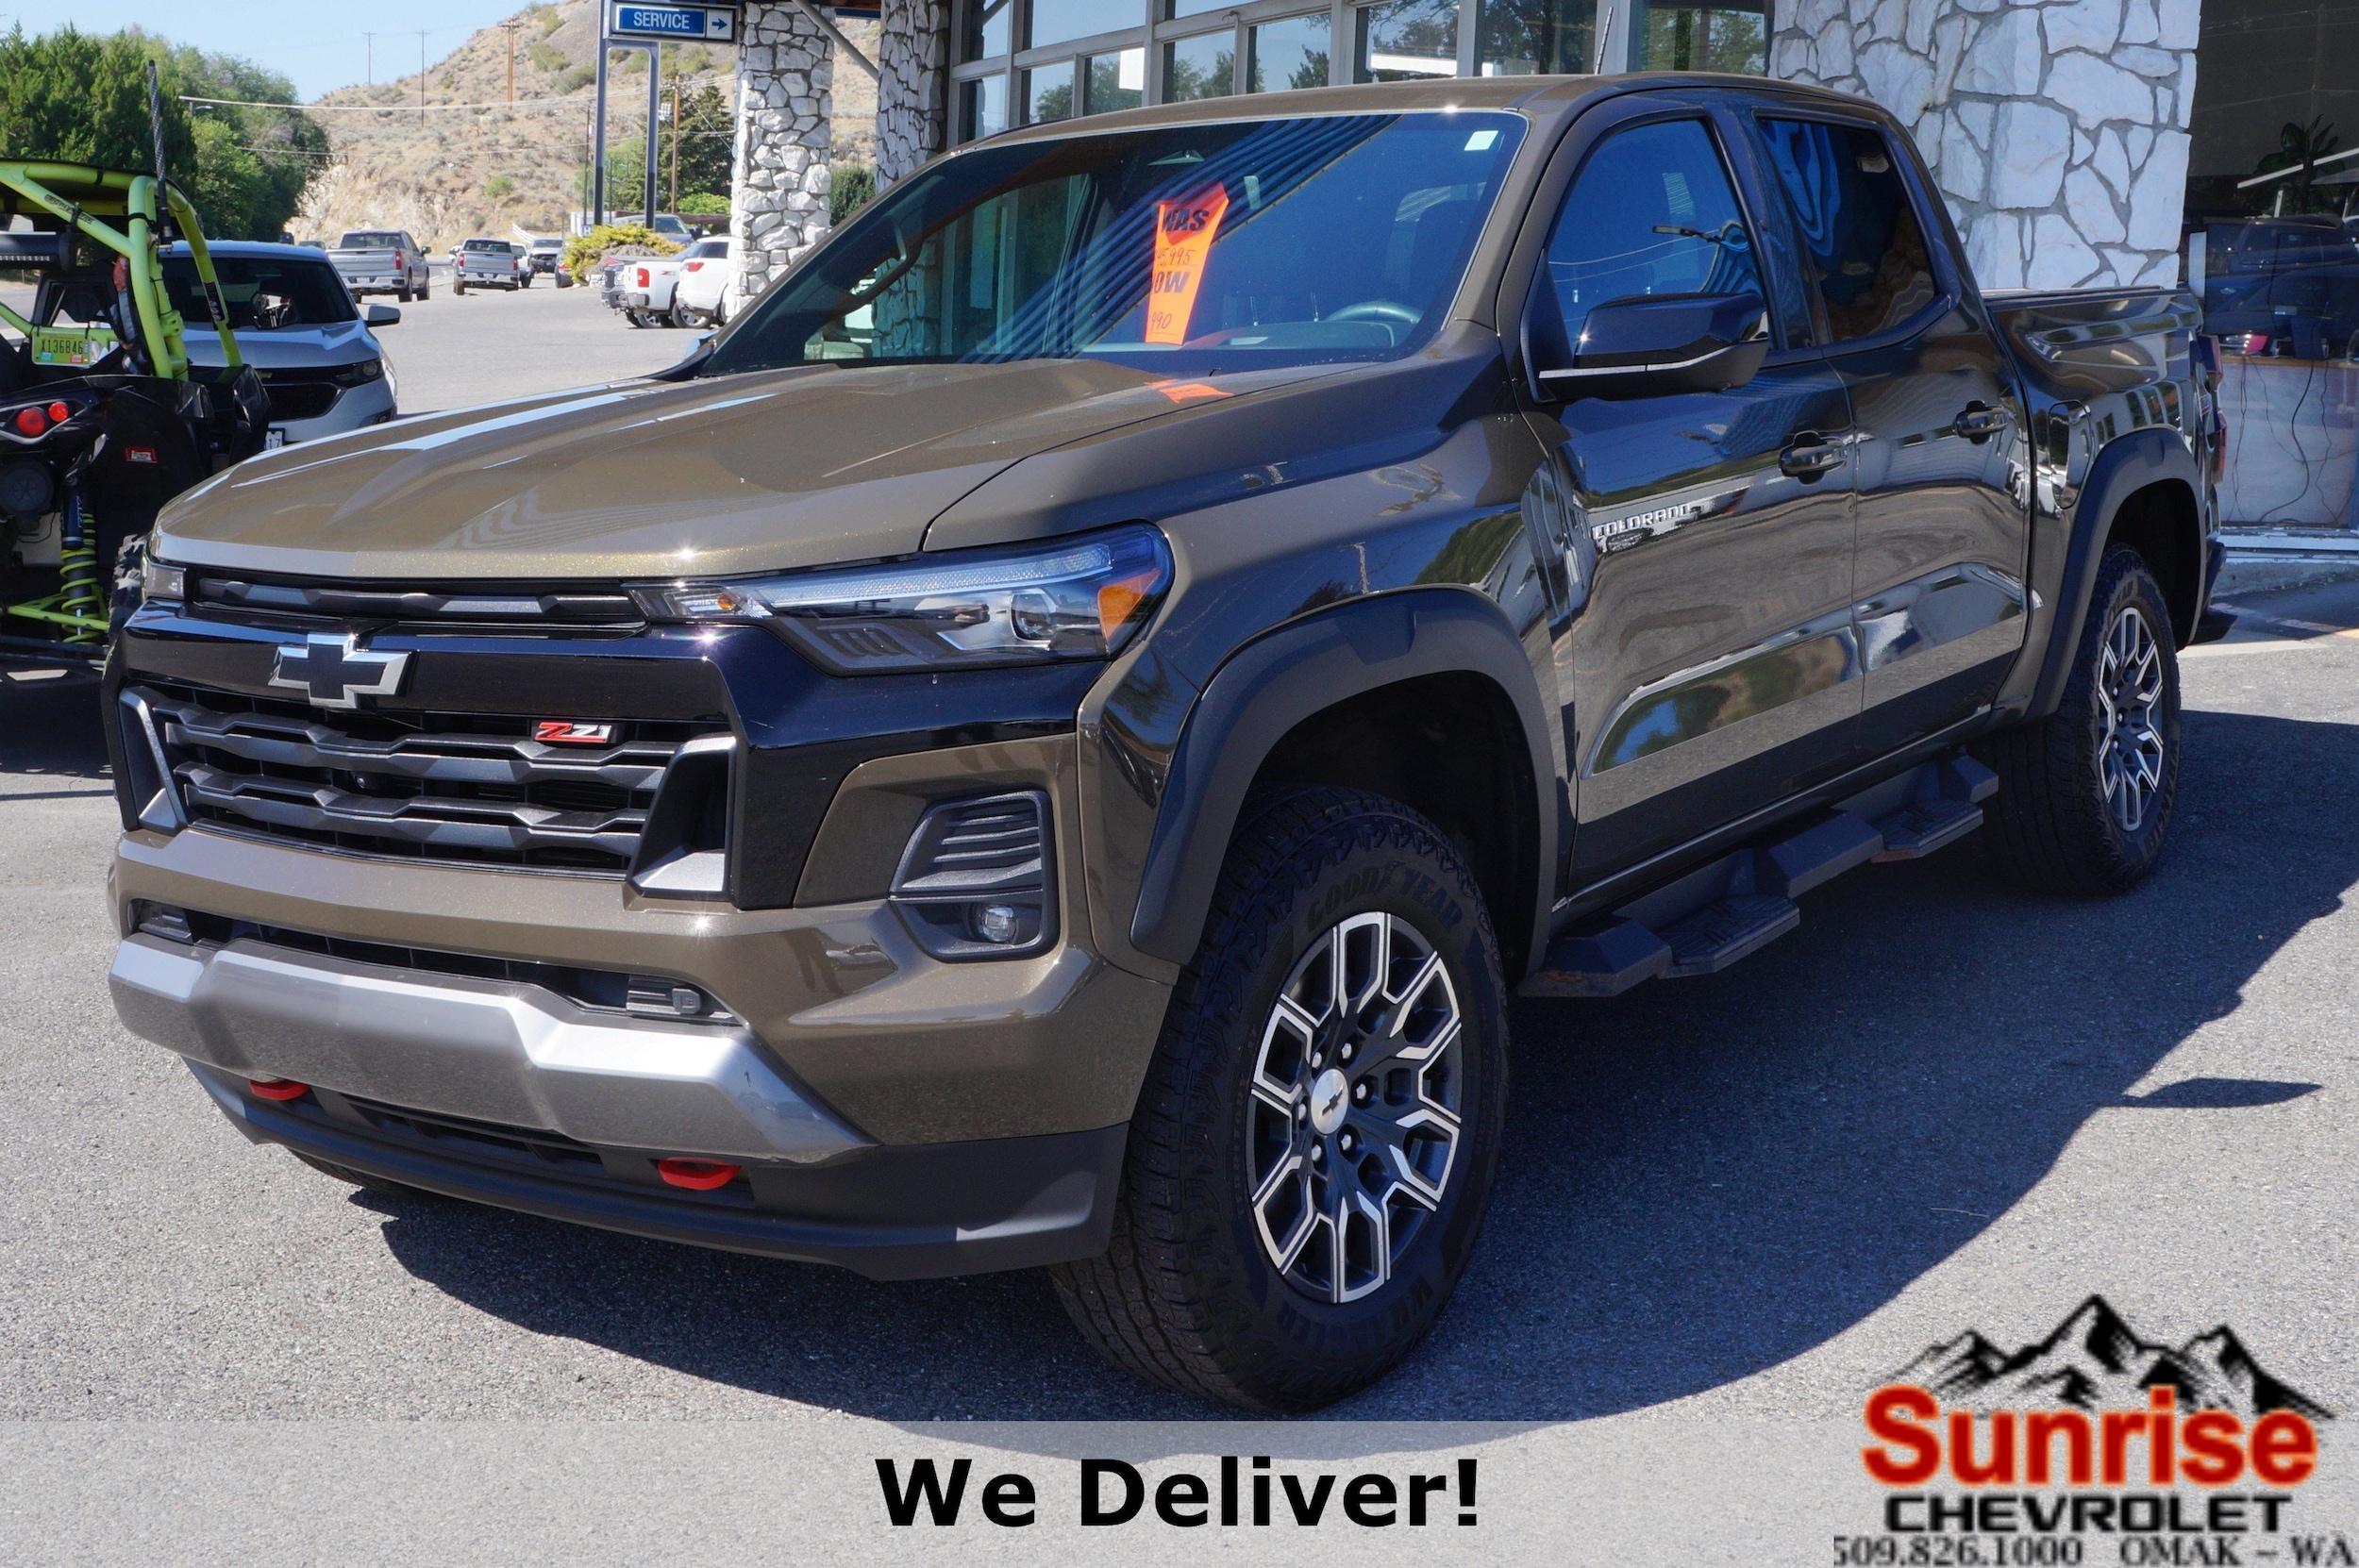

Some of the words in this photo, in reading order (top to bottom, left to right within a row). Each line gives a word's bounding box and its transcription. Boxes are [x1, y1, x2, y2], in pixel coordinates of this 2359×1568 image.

[632, 11, 690, 29] SERVICE
[1162, 209, 1210, 232] WAS
[1152, 271, 1191, 293] OW
[1590, 503, 1692, 541] COLORADO
[535, 722, 612, 742] Z71
